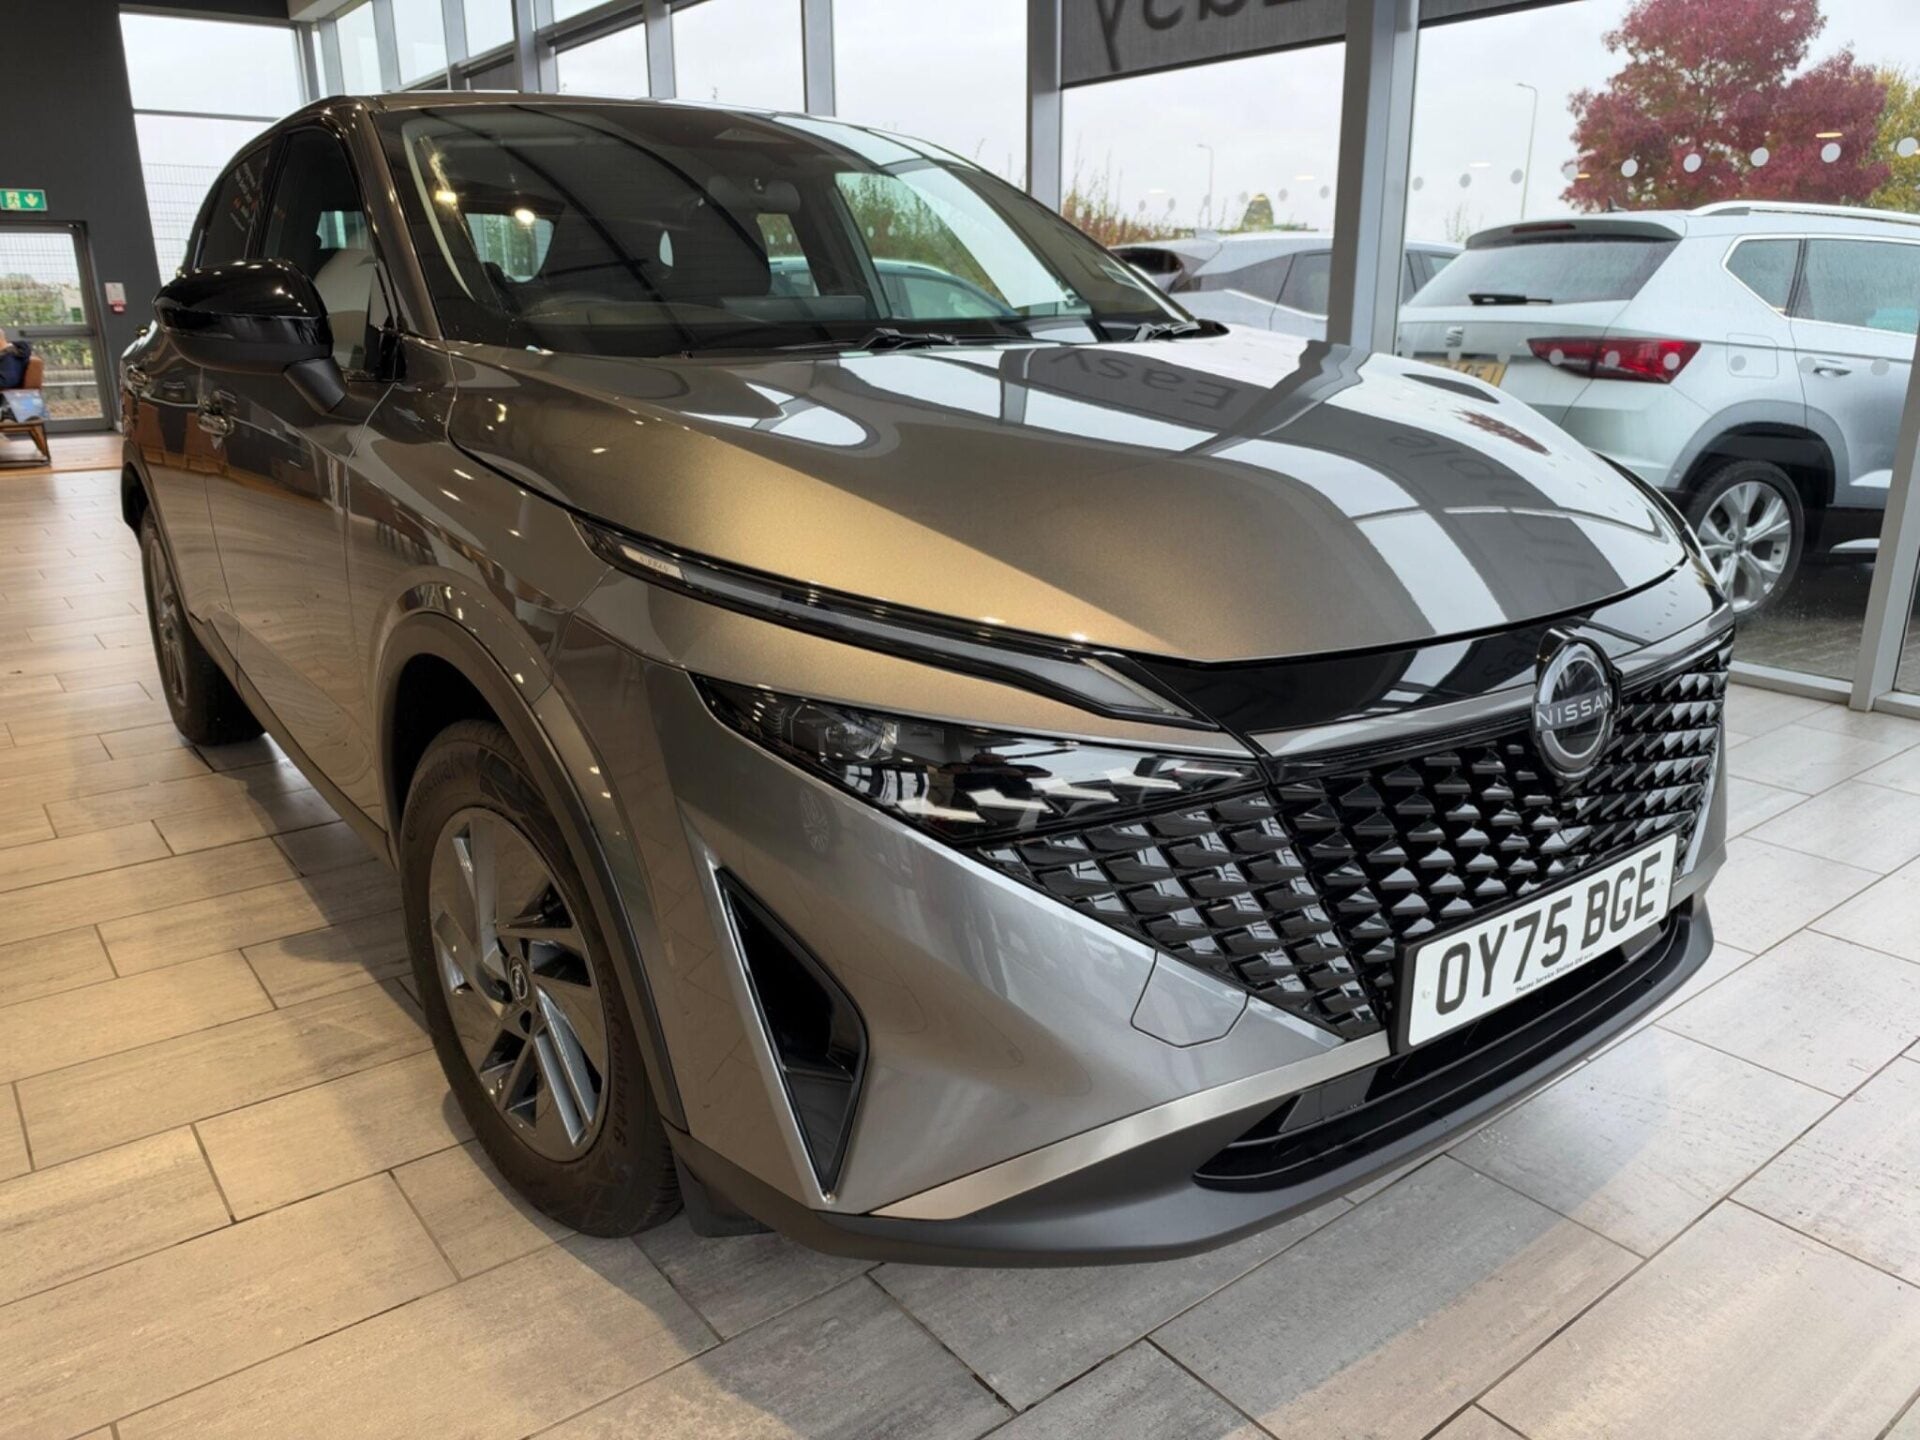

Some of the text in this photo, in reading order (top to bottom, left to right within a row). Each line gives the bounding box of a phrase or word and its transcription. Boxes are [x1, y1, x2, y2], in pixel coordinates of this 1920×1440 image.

[1536, 688, 1613, 727] NISSAN
[1435, 851, 1662, 1016] OY75 BGE
